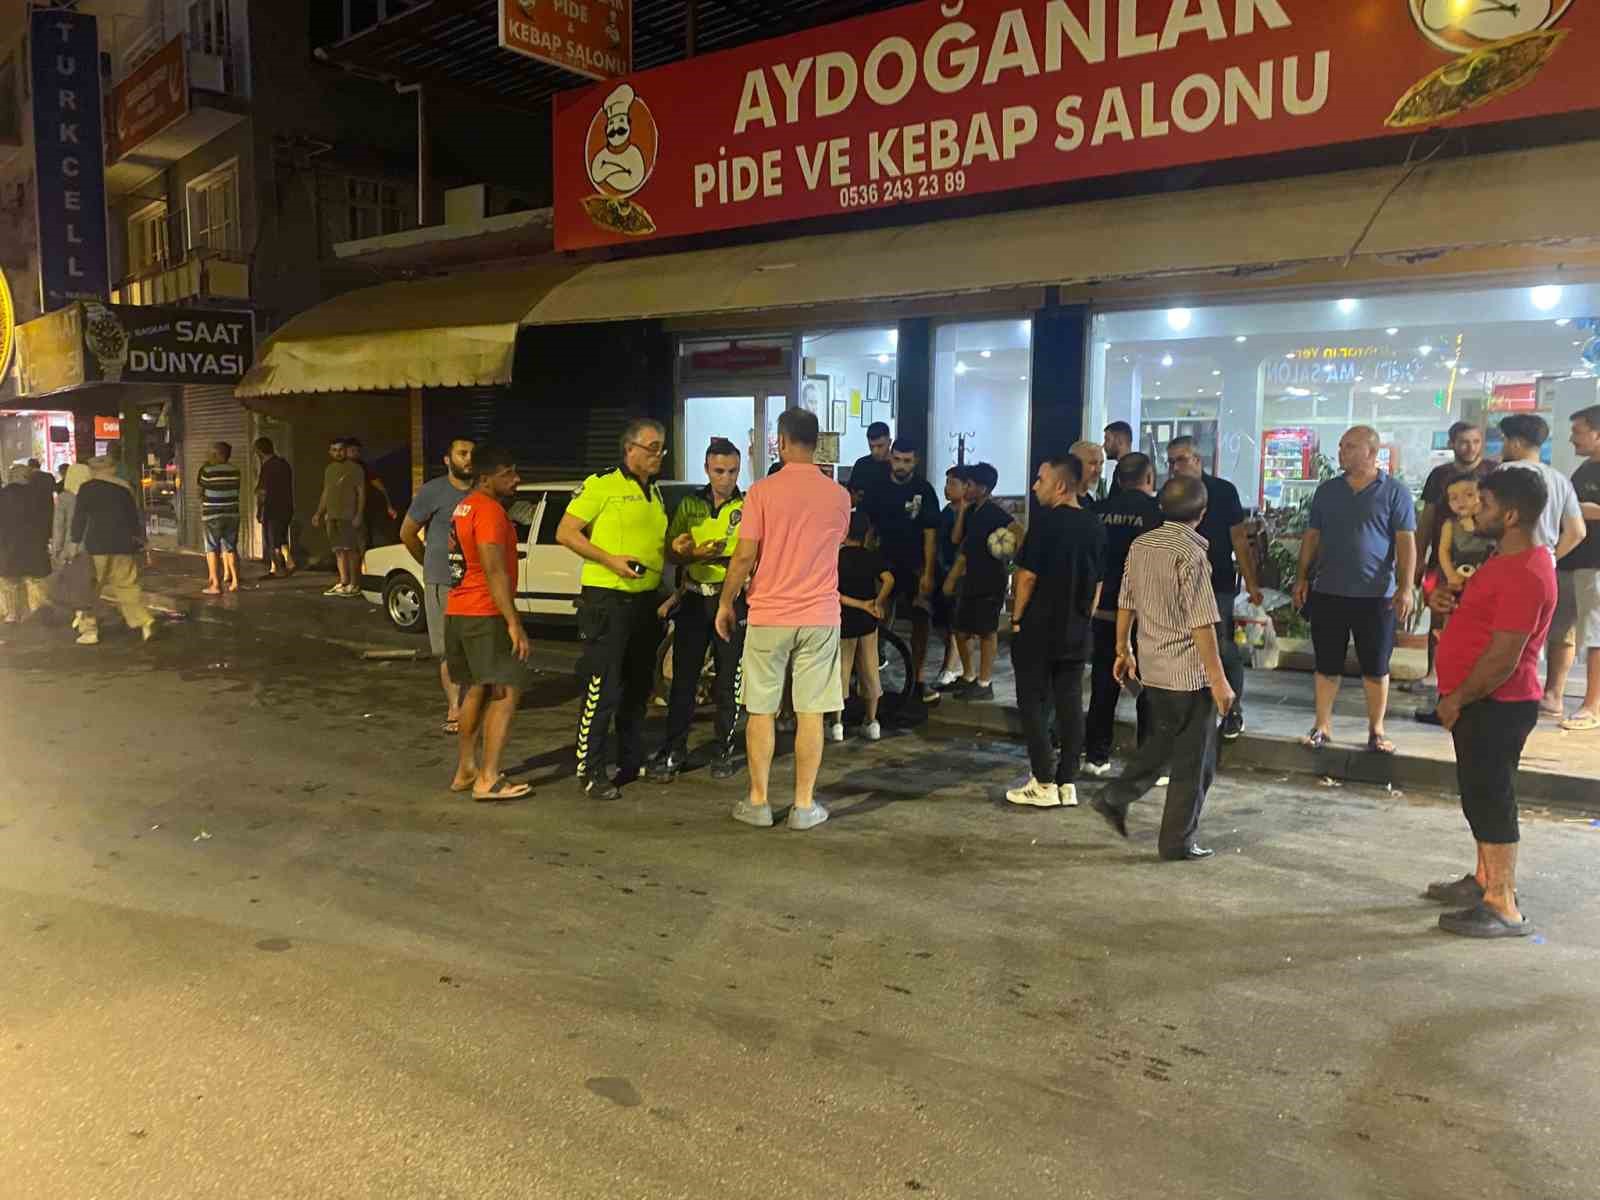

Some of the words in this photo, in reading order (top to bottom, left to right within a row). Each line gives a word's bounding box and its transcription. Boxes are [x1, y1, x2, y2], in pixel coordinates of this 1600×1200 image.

[508, 18, 562, 50] KEBAP
[566, 40, 627, 73] SALONU
[55, 21, 85, 278] TURKCELL
[694, 146, 783, 208] PİDE
[796, 137, 850, 191] VE
[868, 104, 1039, 181] KEBAP
[1054, 50, 1331, 151] SALONU
[840, 183, 879, 208] 0536
[883, 178, 914, 202] 243
[918, 174, 939, 197] 23
[944, 170, 966, 193] 89
[175, 320, 243, 345] SAAT
[129, 346, 244, 376] DÜNYASI
